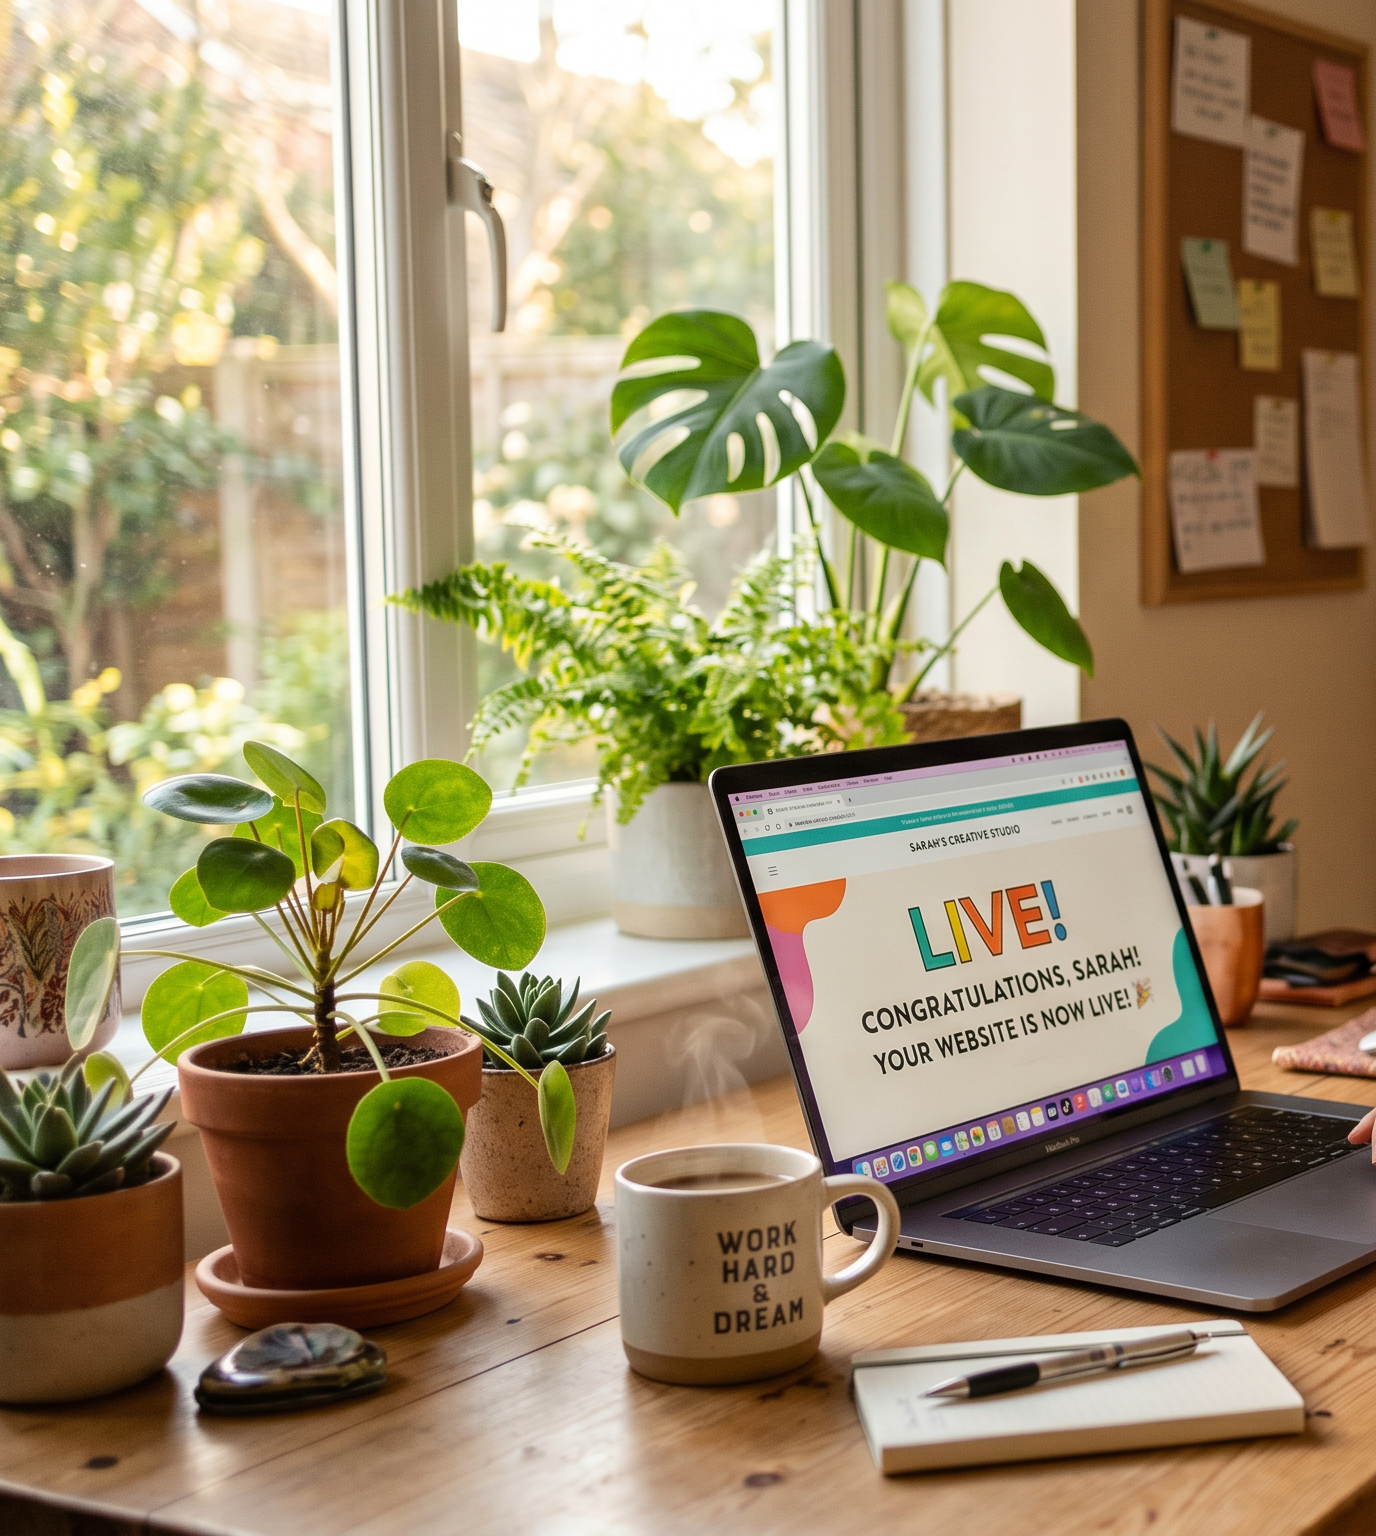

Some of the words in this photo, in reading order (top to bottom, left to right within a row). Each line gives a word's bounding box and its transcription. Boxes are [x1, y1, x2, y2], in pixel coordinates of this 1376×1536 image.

[909, 836, 948, 853] SARAH'S
[948, 829, 990, 846] CREATIVE
[989, 824, 1021, 839] STUDIO
[907, 879, 1068, 972] LIVE!
[861, 964, 1072, 1034] CONGRATULATIONS,
[1072, 945, 1142, 981] SARAH!
[872, 1041, 934, 1075] YOUR
[934, 1018, 1019, 1059] WEBSITE
[1019, 1013, 1039, 1036] IS
[1040, 1000, 1085, 1031] NOW
[1088, 988, 1132, 1018] LIVE!
[717, 1220, 797, 1255] WORK
[722, 1250, 795, 1284] HARD
[753, 1283, 770, 1303] &
[713, 1296, 804, 1335] DREAM
